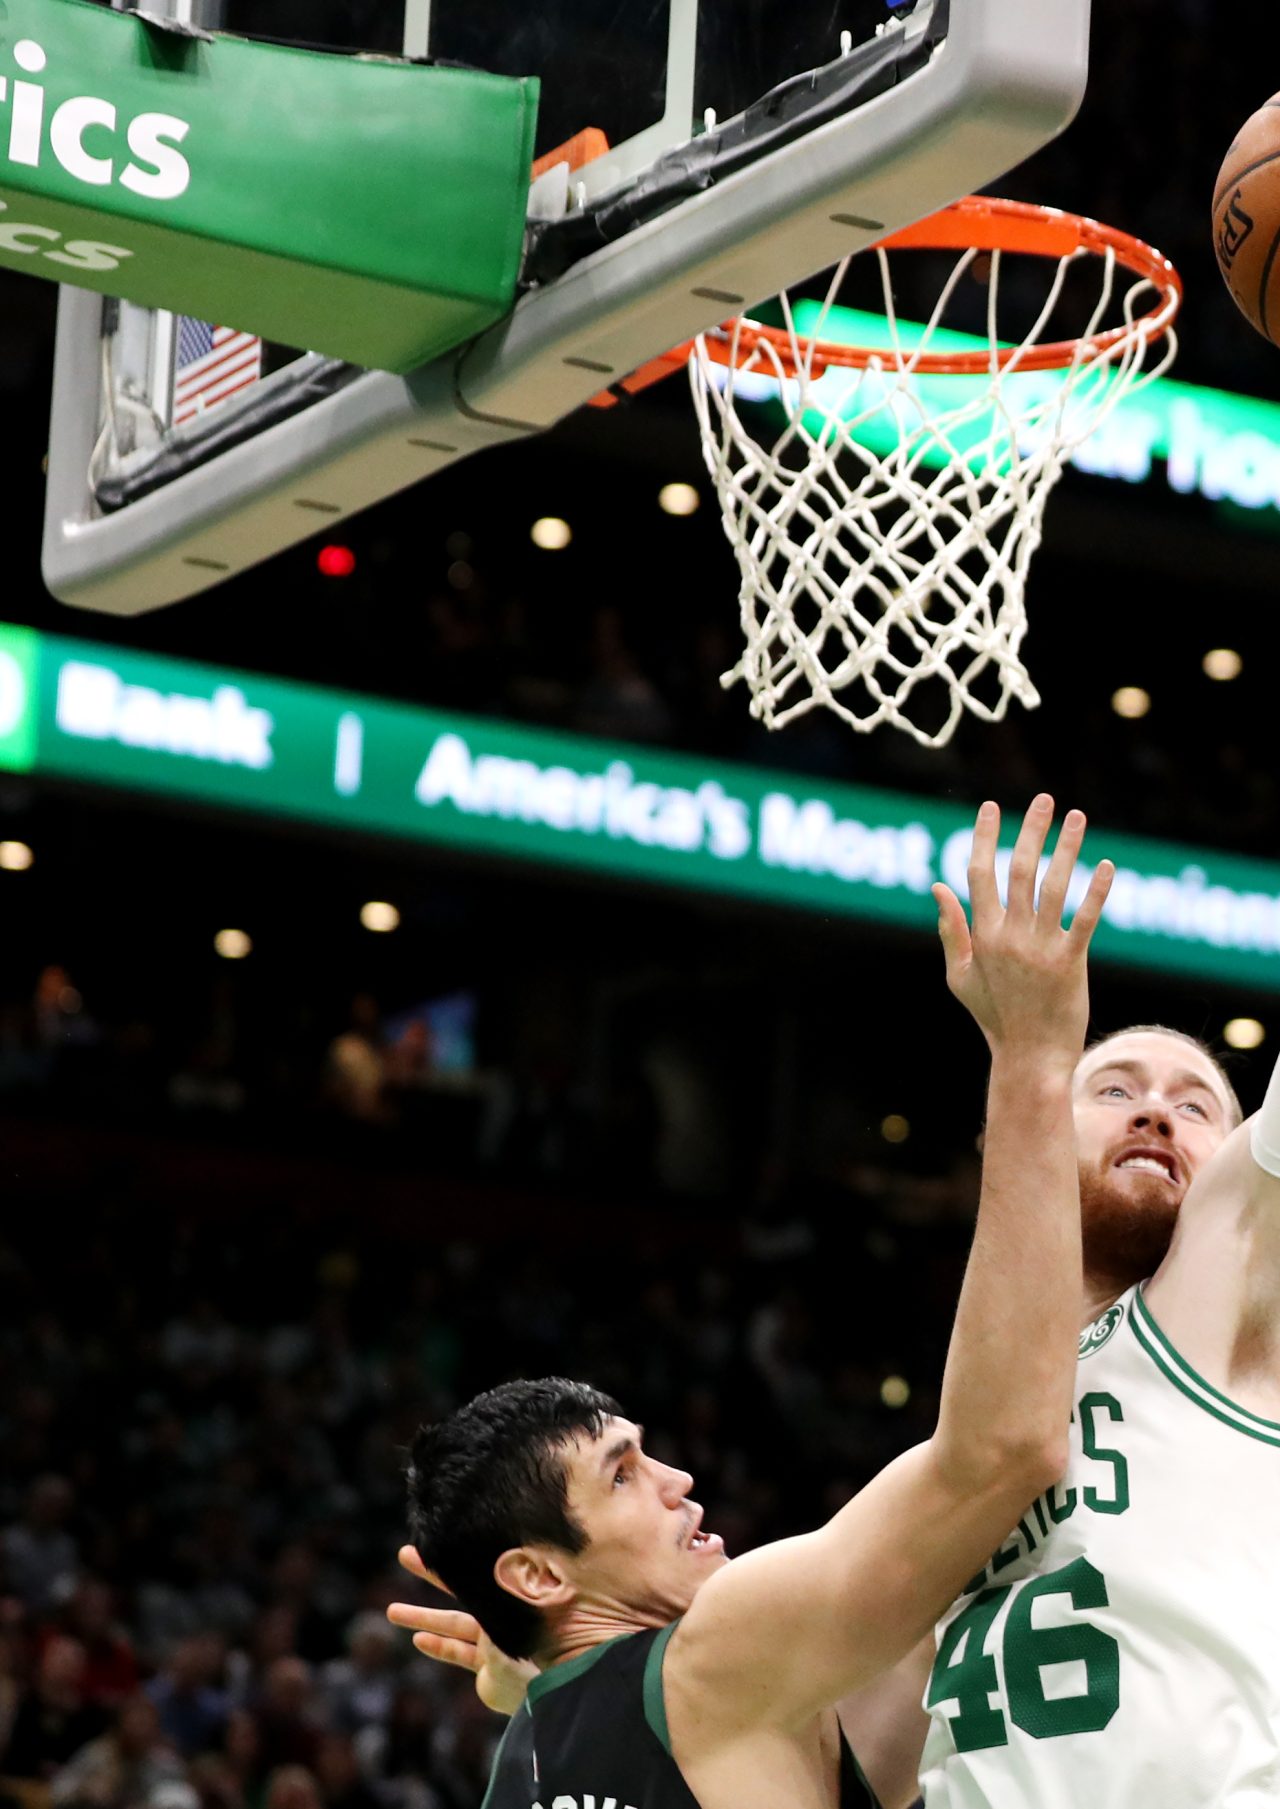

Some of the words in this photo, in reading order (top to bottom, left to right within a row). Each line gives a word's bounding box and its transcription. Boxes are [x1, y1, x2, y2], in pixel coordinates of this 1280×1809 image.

[0, 39, 190, 200] ics
[0, 203, 134, 271] cs
[56, 658, 275, 771] Bank
[414, 731, 751, 860] America's
[758, 791, 936, 895] Most
[926, 1555, 1120, 1754] 46
